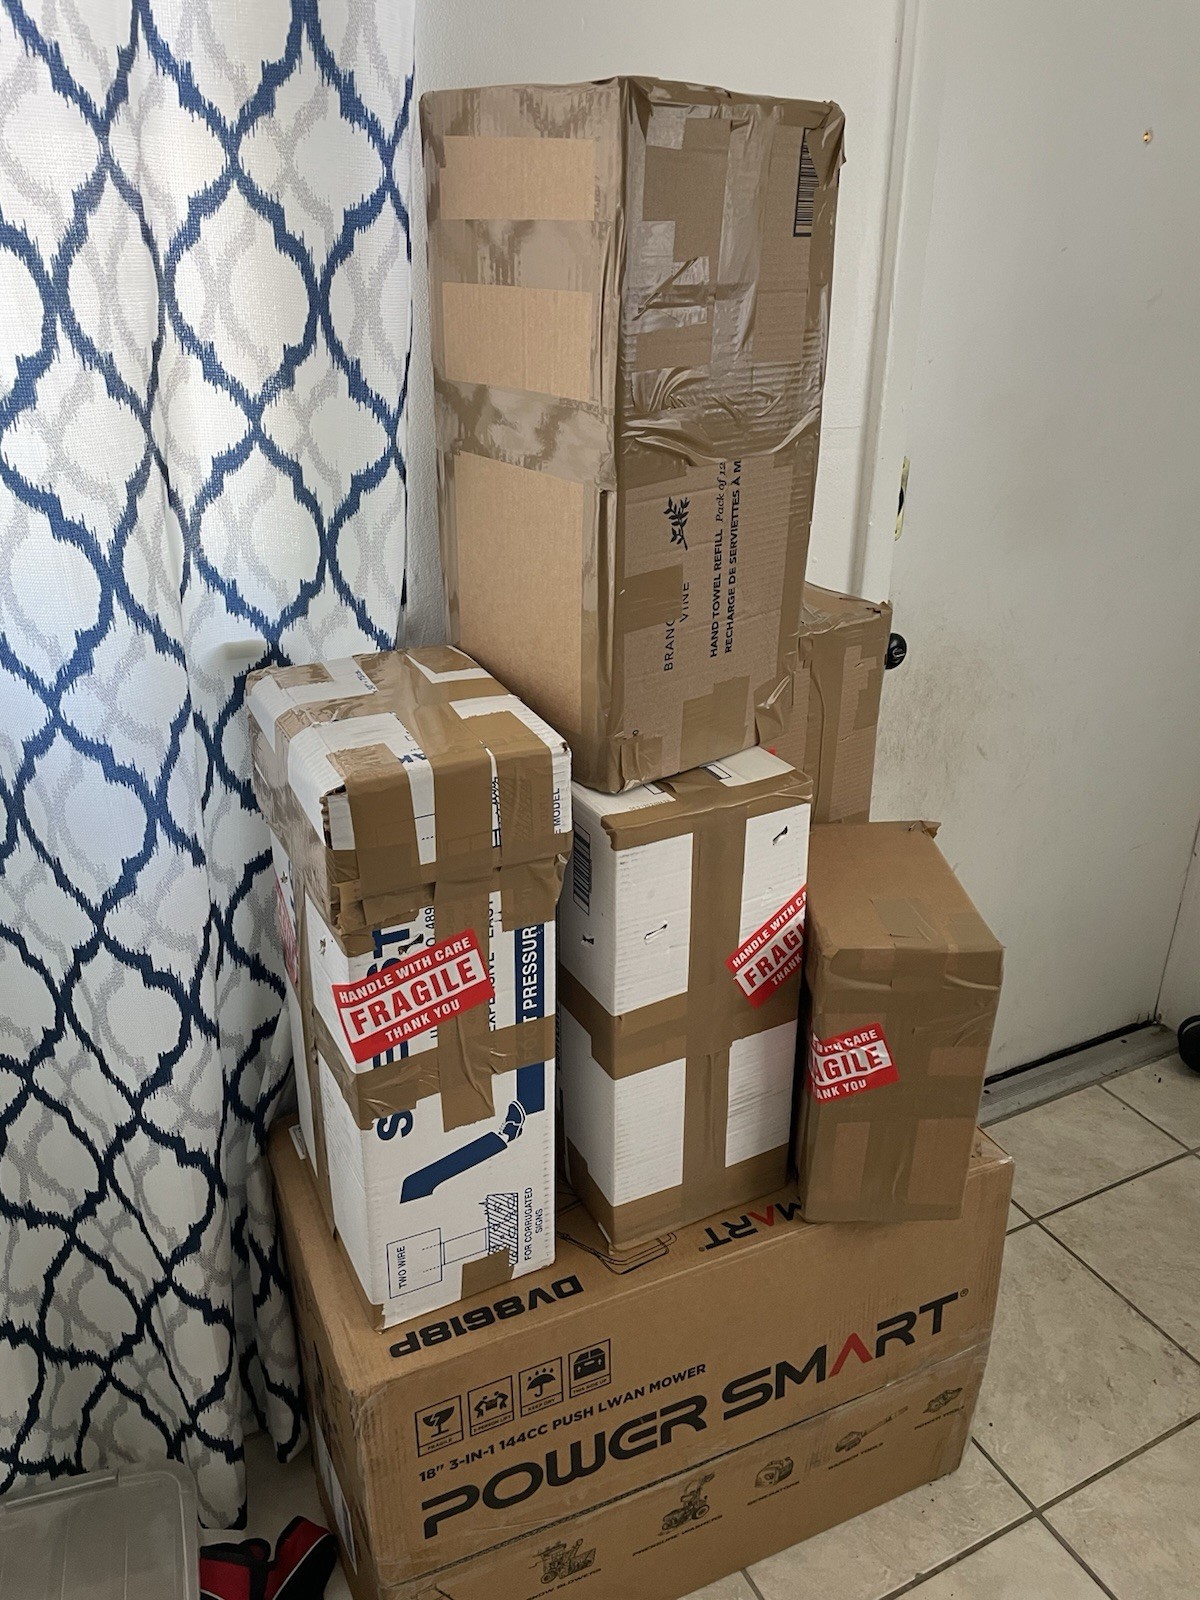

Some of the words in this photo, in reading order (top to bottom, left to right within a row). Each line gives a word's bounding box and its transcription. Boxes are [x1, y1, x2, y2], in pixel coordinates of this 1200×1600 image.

[717, 476, 727, 491] of
[715, 493, 725, 522] Pack
[729, 489, 740, 564] SERVIETTES
[713, 529, 723, 571] REFILL
[712, 573, 721, 619] TOWEL
[728, 566, 737, 585] DE
[710, 620, 719, 657] HAND
[725, 587, 736, 654] RECHARGE
[732, 929, 771, 968] HANDLE
[769, 904, 796, 931] WITH
[339, 973, 394, 1004] HANDLE
[395, 954, 433, 980] WITH
[434, 936, 472, 962] CARE
[771, 953, 803, 985] THANK
[349, 956, 477, 1036] FRAGILE
[384, 1012, 431, 1042] THANK
[433, 998, 460, 1018] YOU
[843, 1029, 878, 1048] CARE
[842, 1079, 867, 1093] YOU
[524, 1187, 533, 1242] CORRUGATED
[535, 1208, 543, 1234] SIGNS
[396, 1245, 406, 1268] WIRE
[524, 1243, 533, 1261] FOR
[398, 1265, 407, 1290] TWO
[389, 1274, 584, 1359] DV8618P
[422, 1394, 708, 1541] POWER
[721, 1290, 959, 1422] SMART
[449, 1444, 495, 1471] 3-IN-1
[498, 1424, 547, 1451] 144CC
[552, 1405, 594, 1431] PUSH
[598, 1386, 645, 1413] LWAN
[649, 1363, 706, 1394] MOWER
